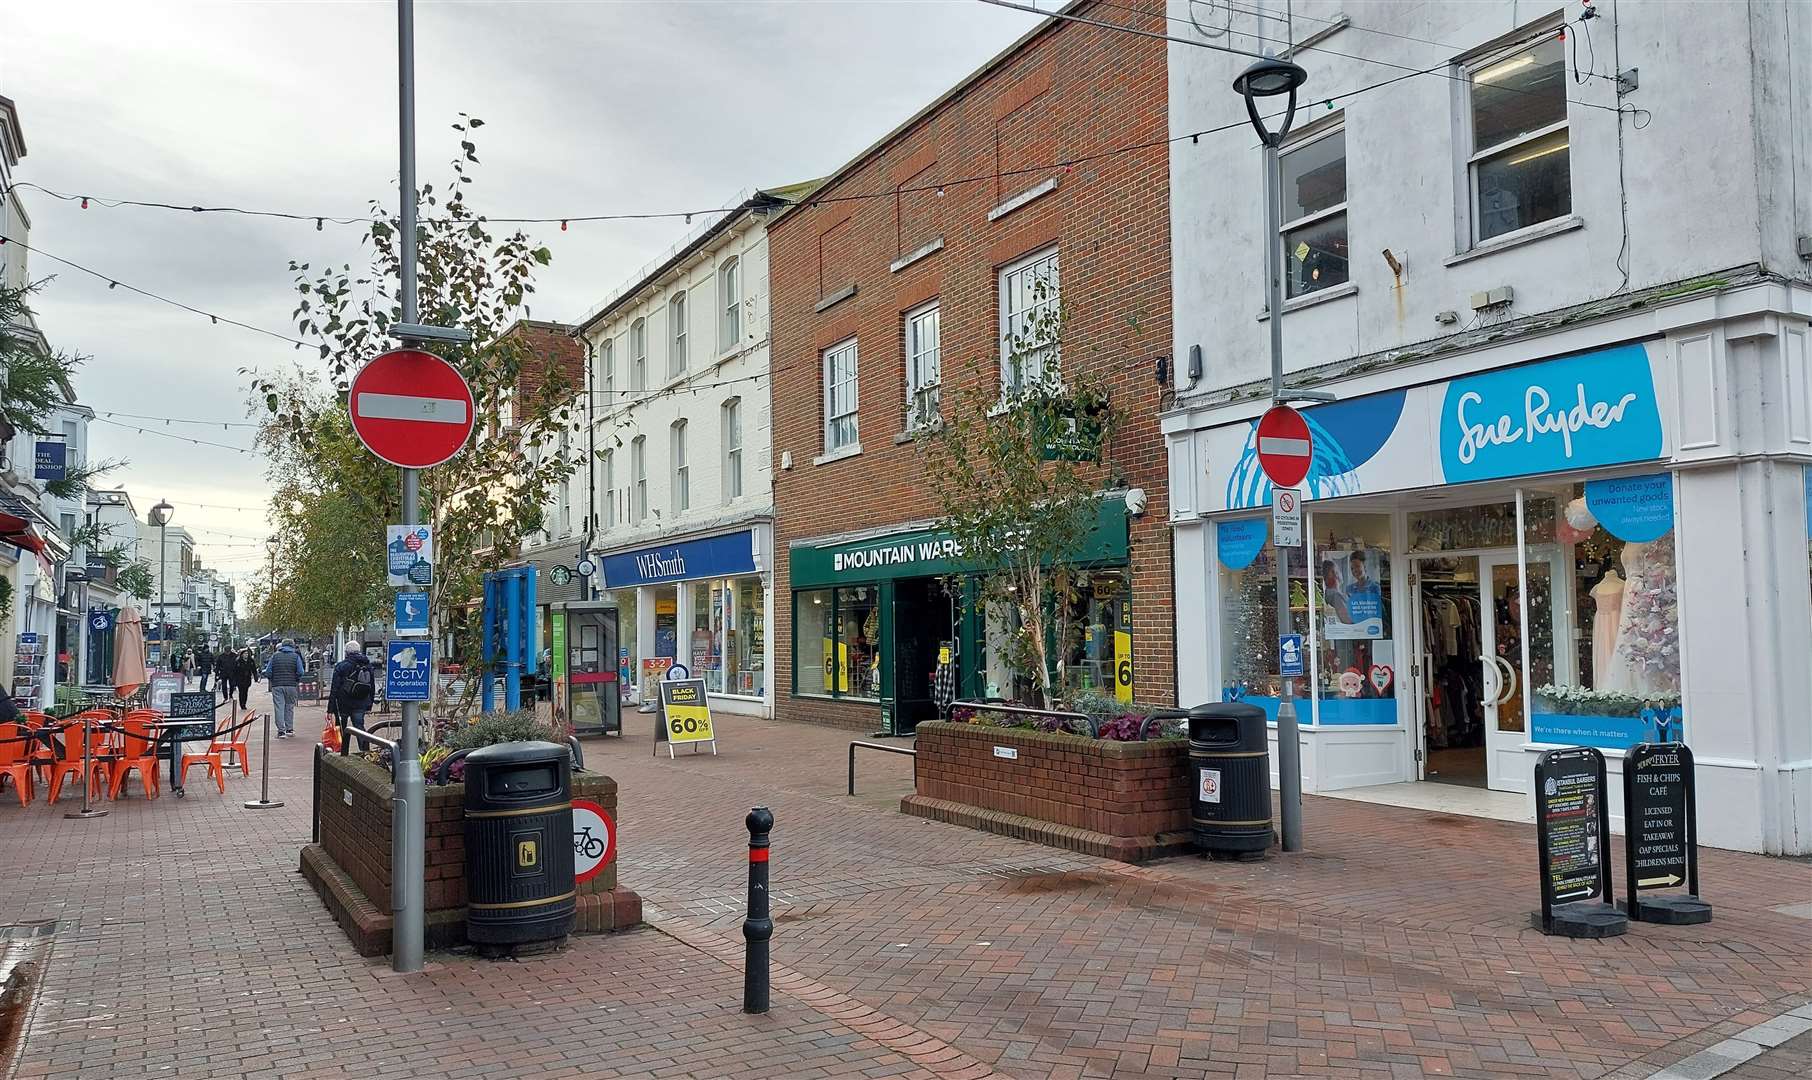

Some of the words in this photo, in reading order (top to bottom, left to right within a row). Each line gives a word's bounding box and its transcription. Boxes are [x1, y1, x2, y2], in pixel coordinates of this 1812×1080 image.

[1458, 391, 1524, 464] Sue
[1525, 383, 1637, 458] Ryder
[1608, 484, 1642, 493] Donate
[1645, 481, 1666, 492] your
[1592, 495, 1638, 506] unwanted
[1640, 491, 1669, 505] goods
[843, 544, 915, 570] MOUNTAIN
[636, 549, 686, 579] WHSmith
[392, 670, 424, 679] CCTV
[1553, 727, 1571, 735] there
[1655, 754, 1680, 764] FRYER
[1636, 774, 1652, 783] FISH
[1653, 774, 1659, 782] &
[1660, 773, 1681, 782] CHIPS
[1644, 806, 1673, 816] LICENSED
[1643, 820, 1655, 828] EAT
[1664, 819, 1673, 827] OR
[1642, 831, 1675, 841] TAKEAWAY
[1639, 846, 1652, 855] OAP
[1652, 844, 1679, 853] SPECIALS
[1667, 856, 1685, 865] MENU
